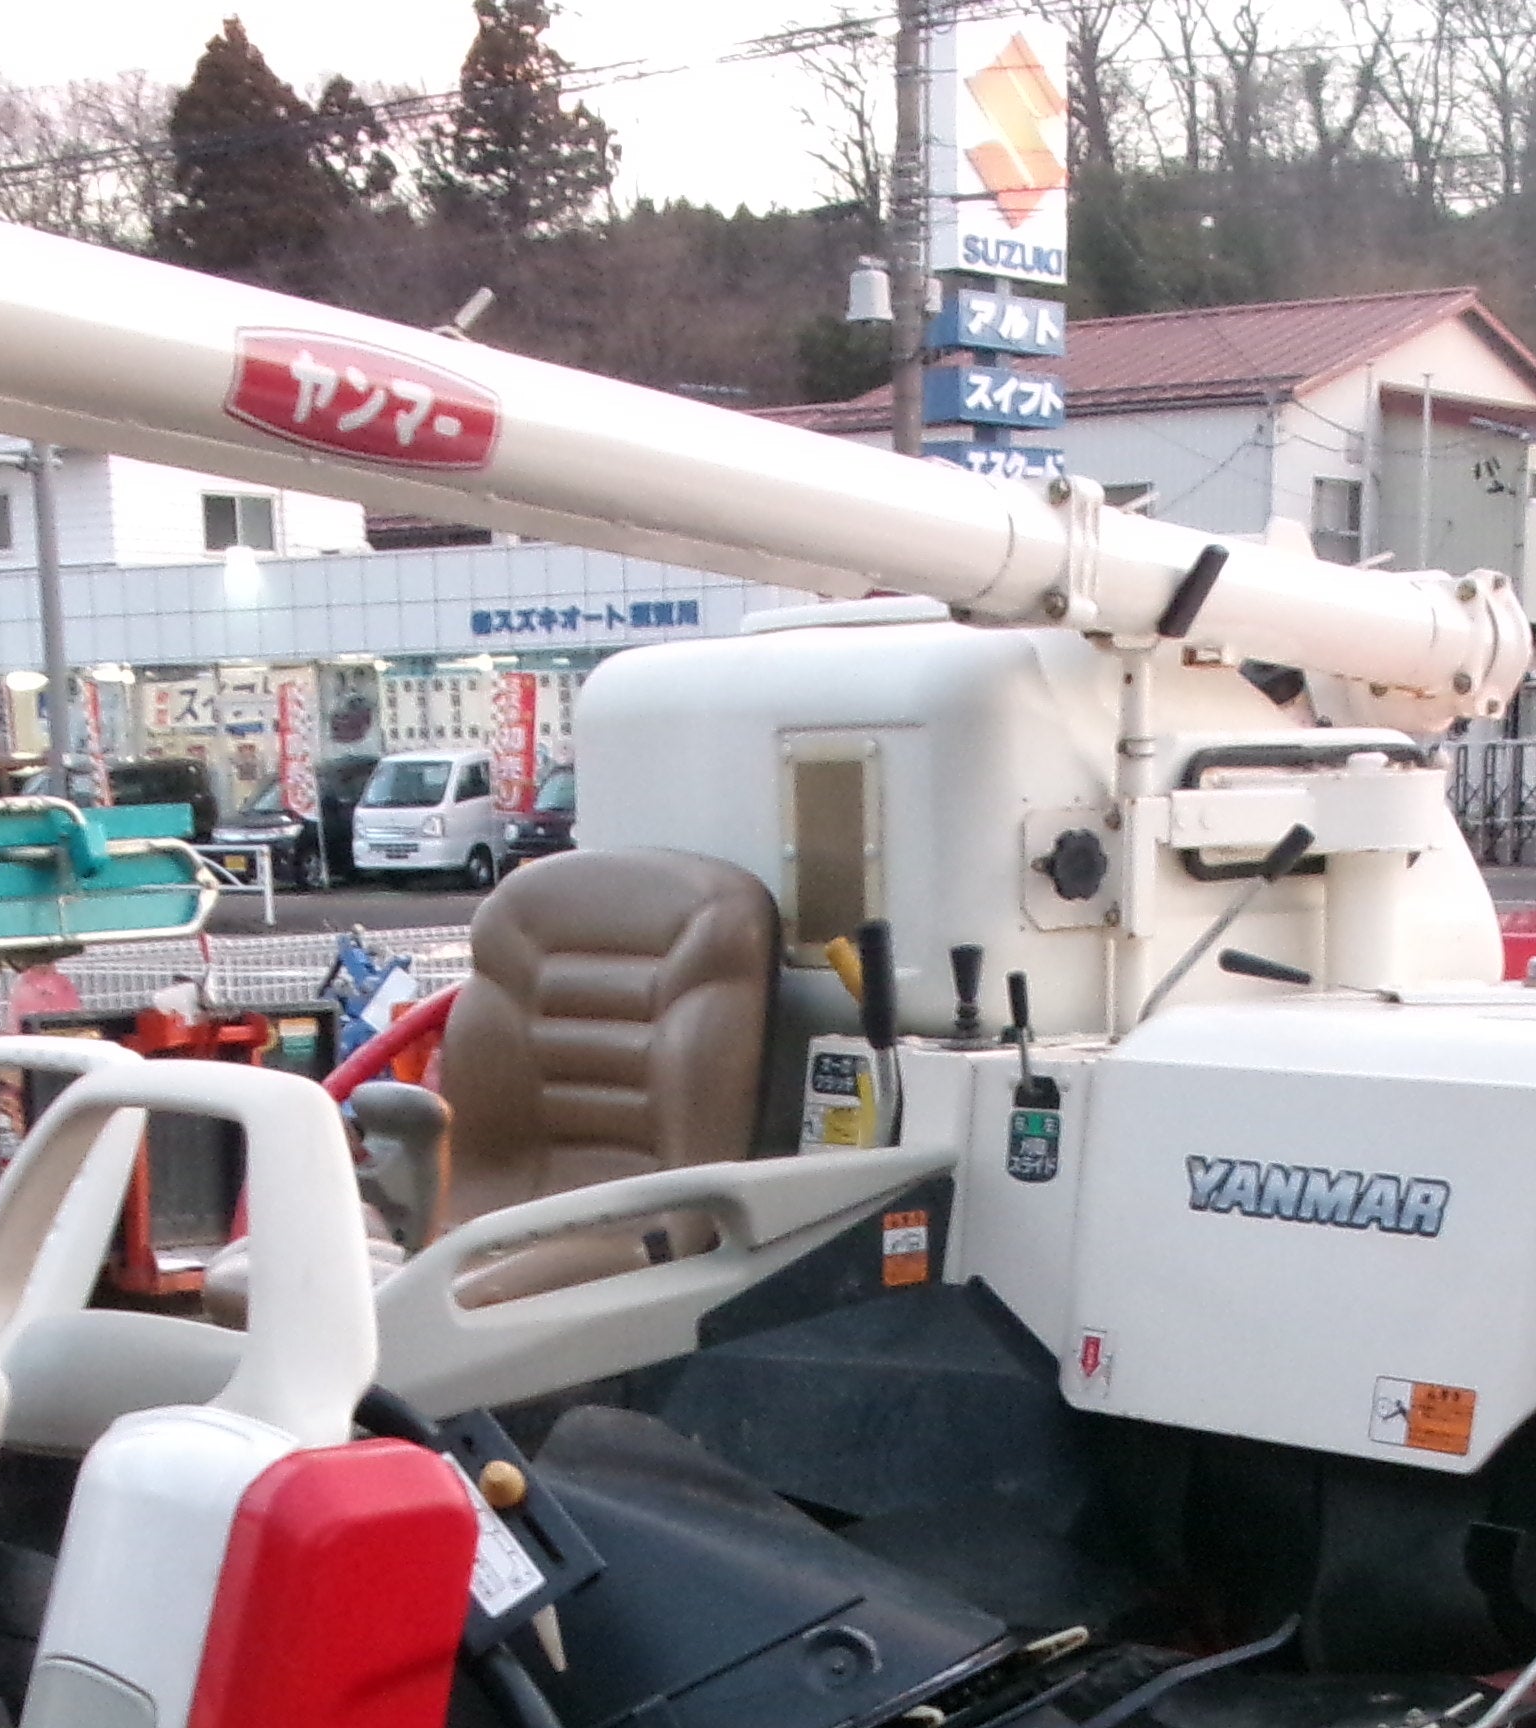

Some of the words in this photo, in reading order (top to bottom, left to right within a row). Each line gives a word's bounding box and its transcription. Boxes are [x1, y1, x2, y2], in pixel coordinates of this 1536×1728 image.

[964, 234, 1064, 277] SUZUKI
[968, 299, 1061, 346] アルト
[290, 349, 463, 447] ヤンマー
[966, 373, 1063, 417] スイフト
[1186, 1154, 1451, 1238] YANMAR
